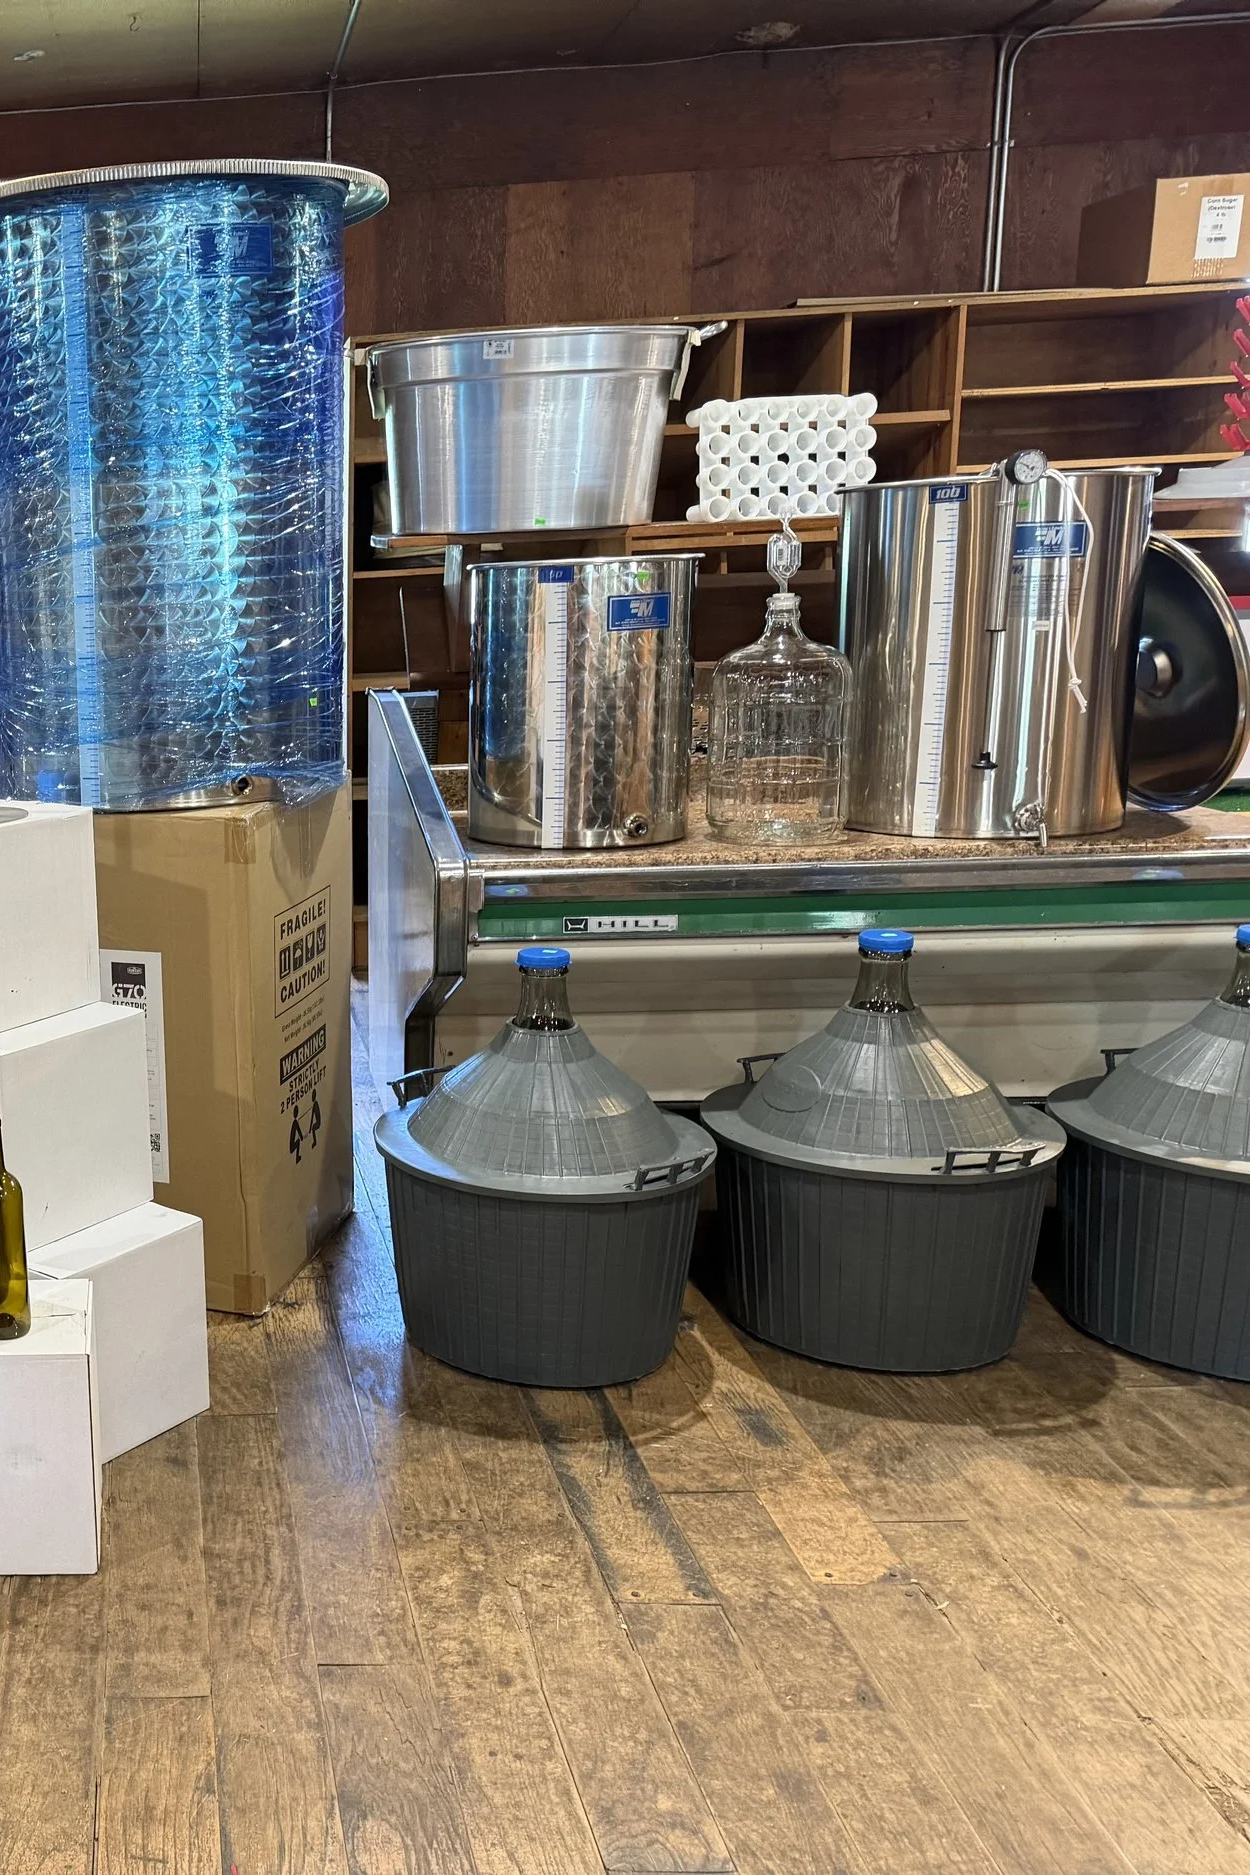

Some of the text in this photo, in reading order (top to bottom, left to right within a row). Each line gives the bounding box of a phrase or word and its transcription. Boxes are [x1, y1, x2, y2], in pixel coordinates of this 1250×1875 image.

[936, 487, 960, 499] 100
[280, 899, 326, 940] FRAGILE!
[598, 919, 669, 928] HILL
[280, 959, 326, 1003] CAUTION!
[282, 1030, 325, 1077] WARNING
[280, 1065, 327, 1115] 2 PERSON LIFT
[289, 1058, 320, 1093] STRICTLY
